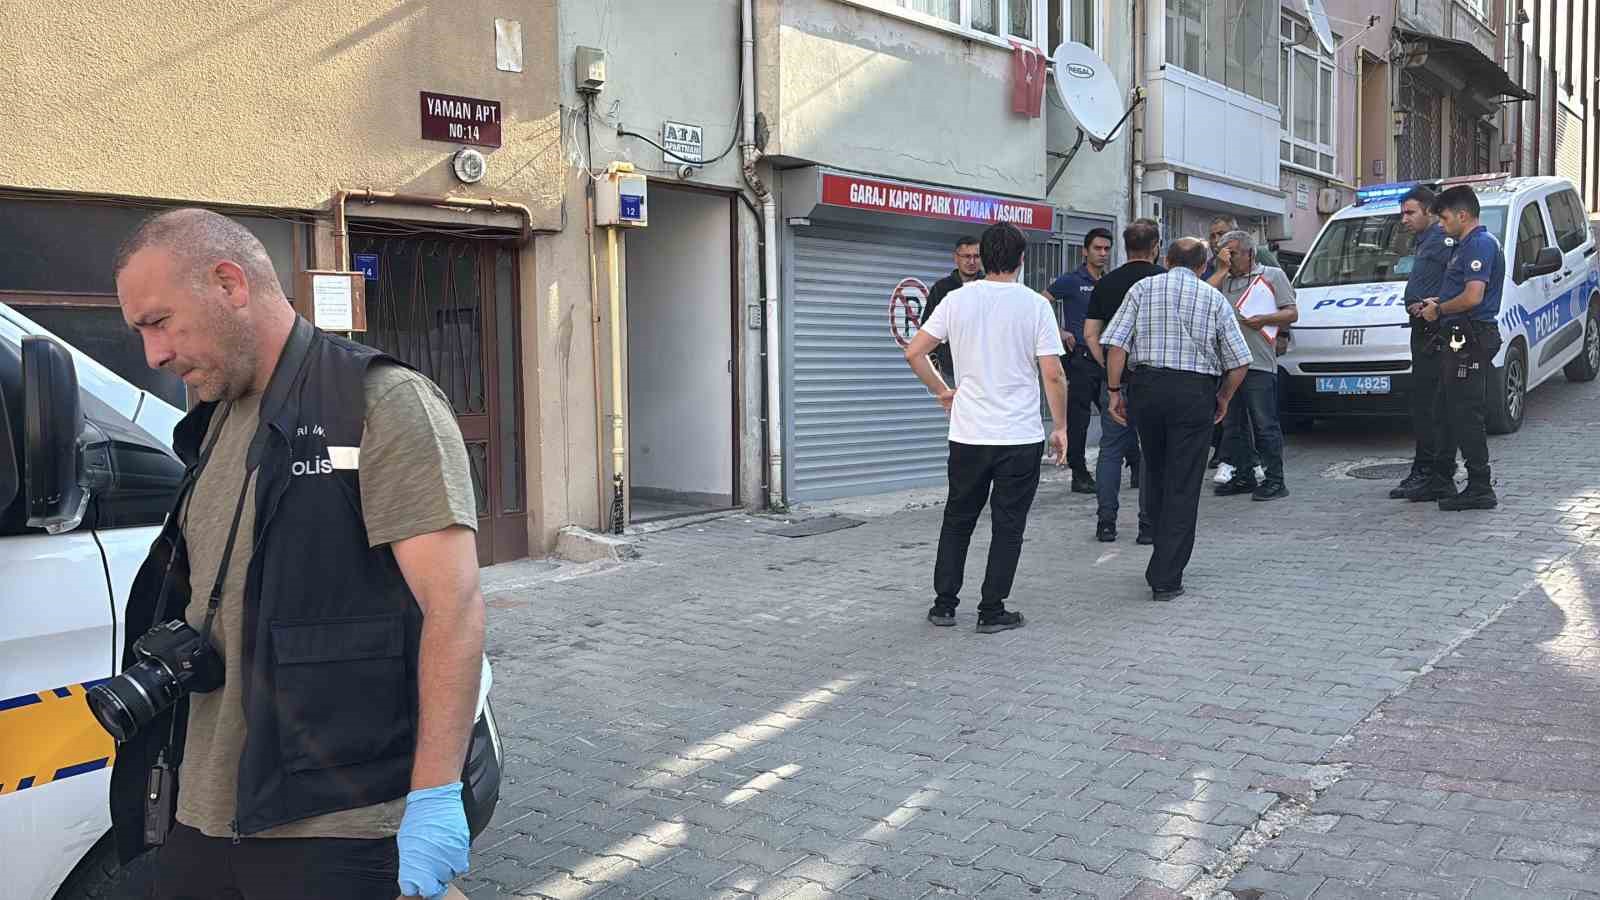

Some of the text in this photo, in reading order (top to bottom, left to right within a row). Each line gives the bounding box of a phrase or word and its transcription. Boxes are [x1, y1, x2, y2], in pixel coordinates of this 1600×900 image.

[427, 97, 499, 124] YAMAN APT.
[449, 122, 480, 141] NO:14
[666, 126, 700, 144] ATA
[626, 207, 636, 217] 12
[850, 183, 1033, 225] GARAJ KAPISI PARK YAPMAK YASAKTIR
[1342, 329, 1366, 346] FIAT
[1319, 376, 1388, 390] 14 A 4825
[292, 455, 333, 476] OLİS
